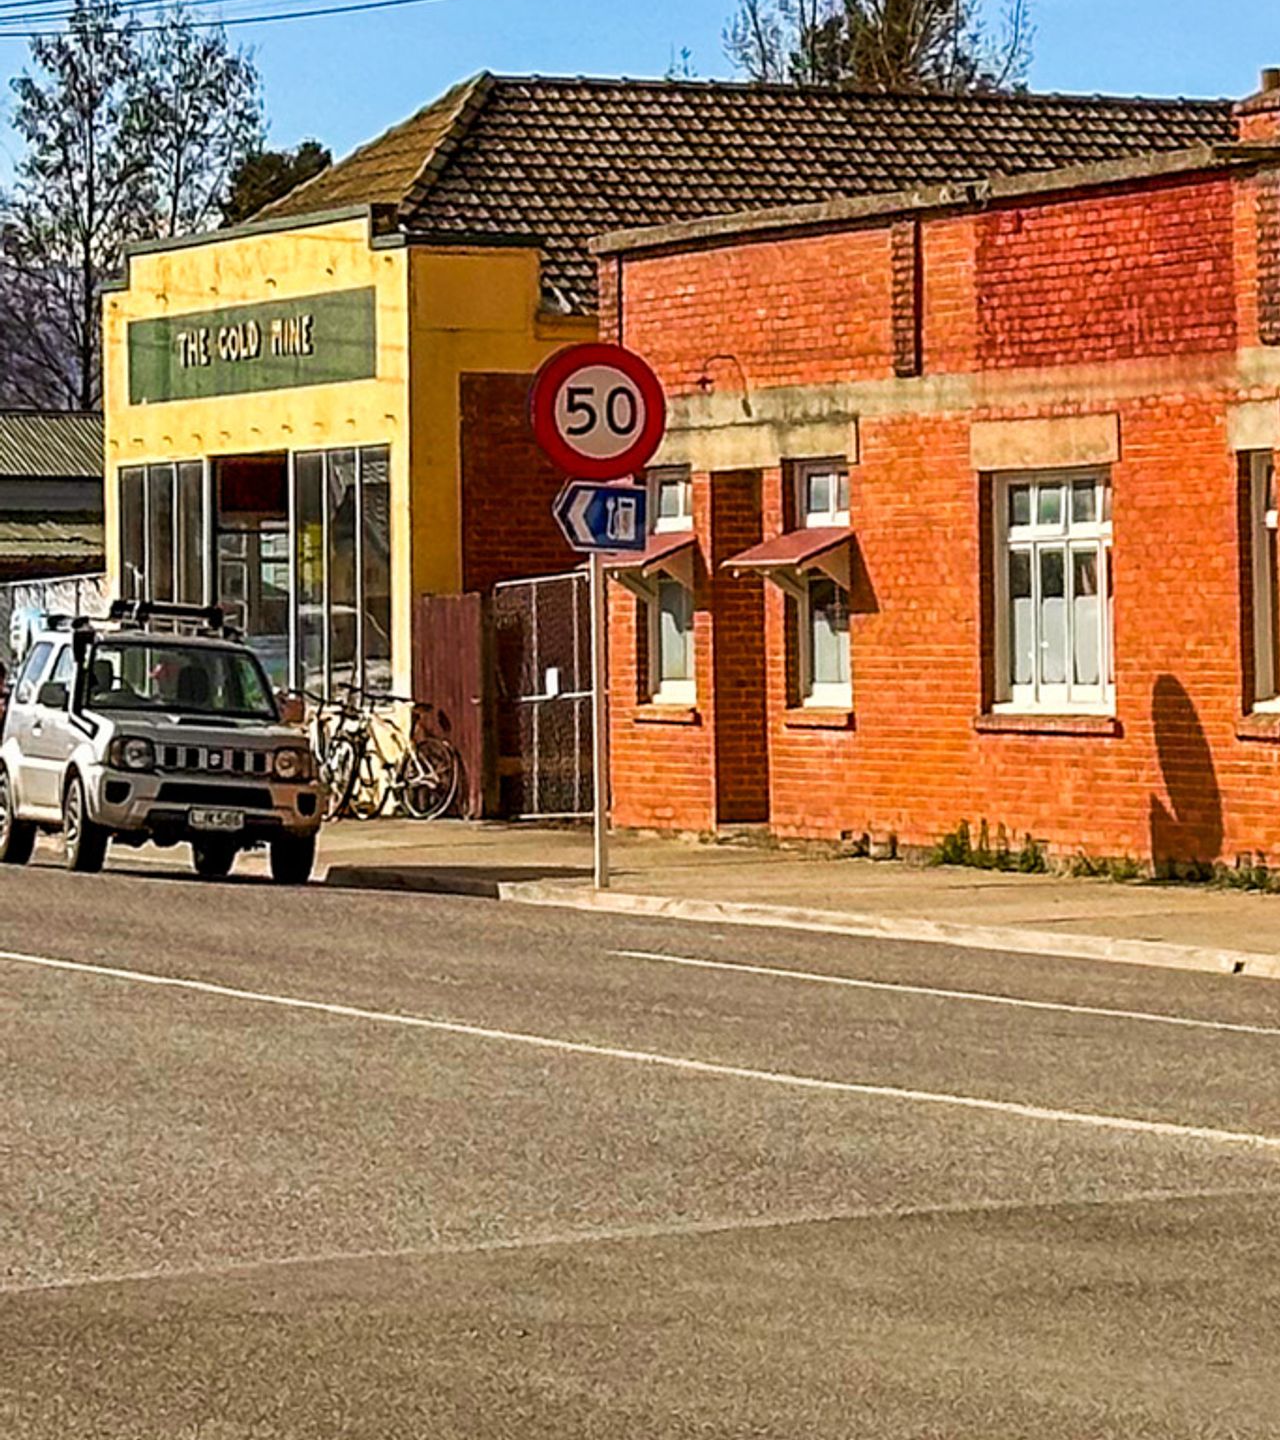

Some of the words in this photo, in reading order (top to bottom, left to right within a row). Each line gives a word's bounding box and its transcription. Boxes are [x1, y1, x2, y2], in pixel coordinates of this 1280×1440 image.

[177, 328, 212, 368] THE
[271, 314, 313, 356] MINE
[565, 386, 638, 436] 50
